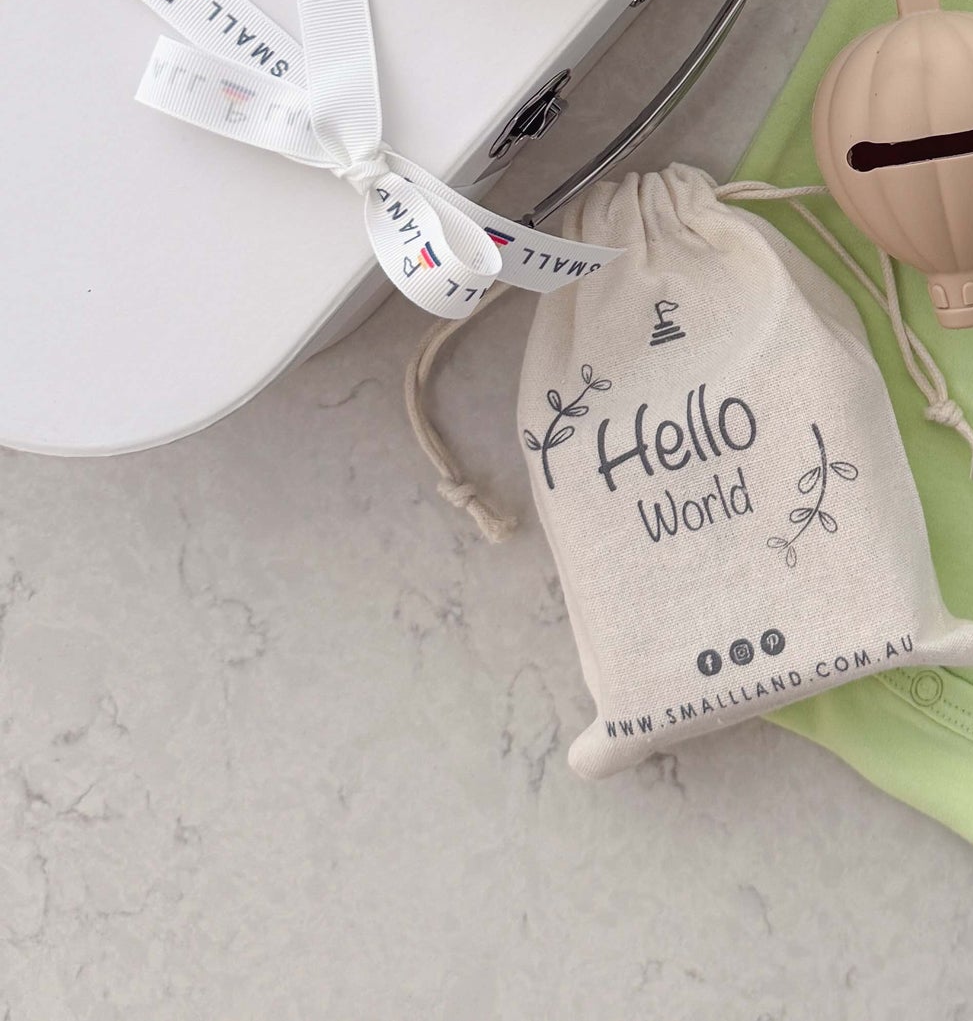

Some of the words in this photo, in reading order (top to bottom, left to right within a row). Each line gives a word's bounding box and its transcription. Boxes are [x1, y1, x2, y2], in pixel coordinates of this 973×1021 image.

[208, 1, 290, 78] SMALL
[376, 188, 421, 245] LAND
[597, 384, 757, 492] Hello
[637, 466, 754, 543] World
[606, 634, 914, 738] WWW.SMALLLAND.COM.AU
